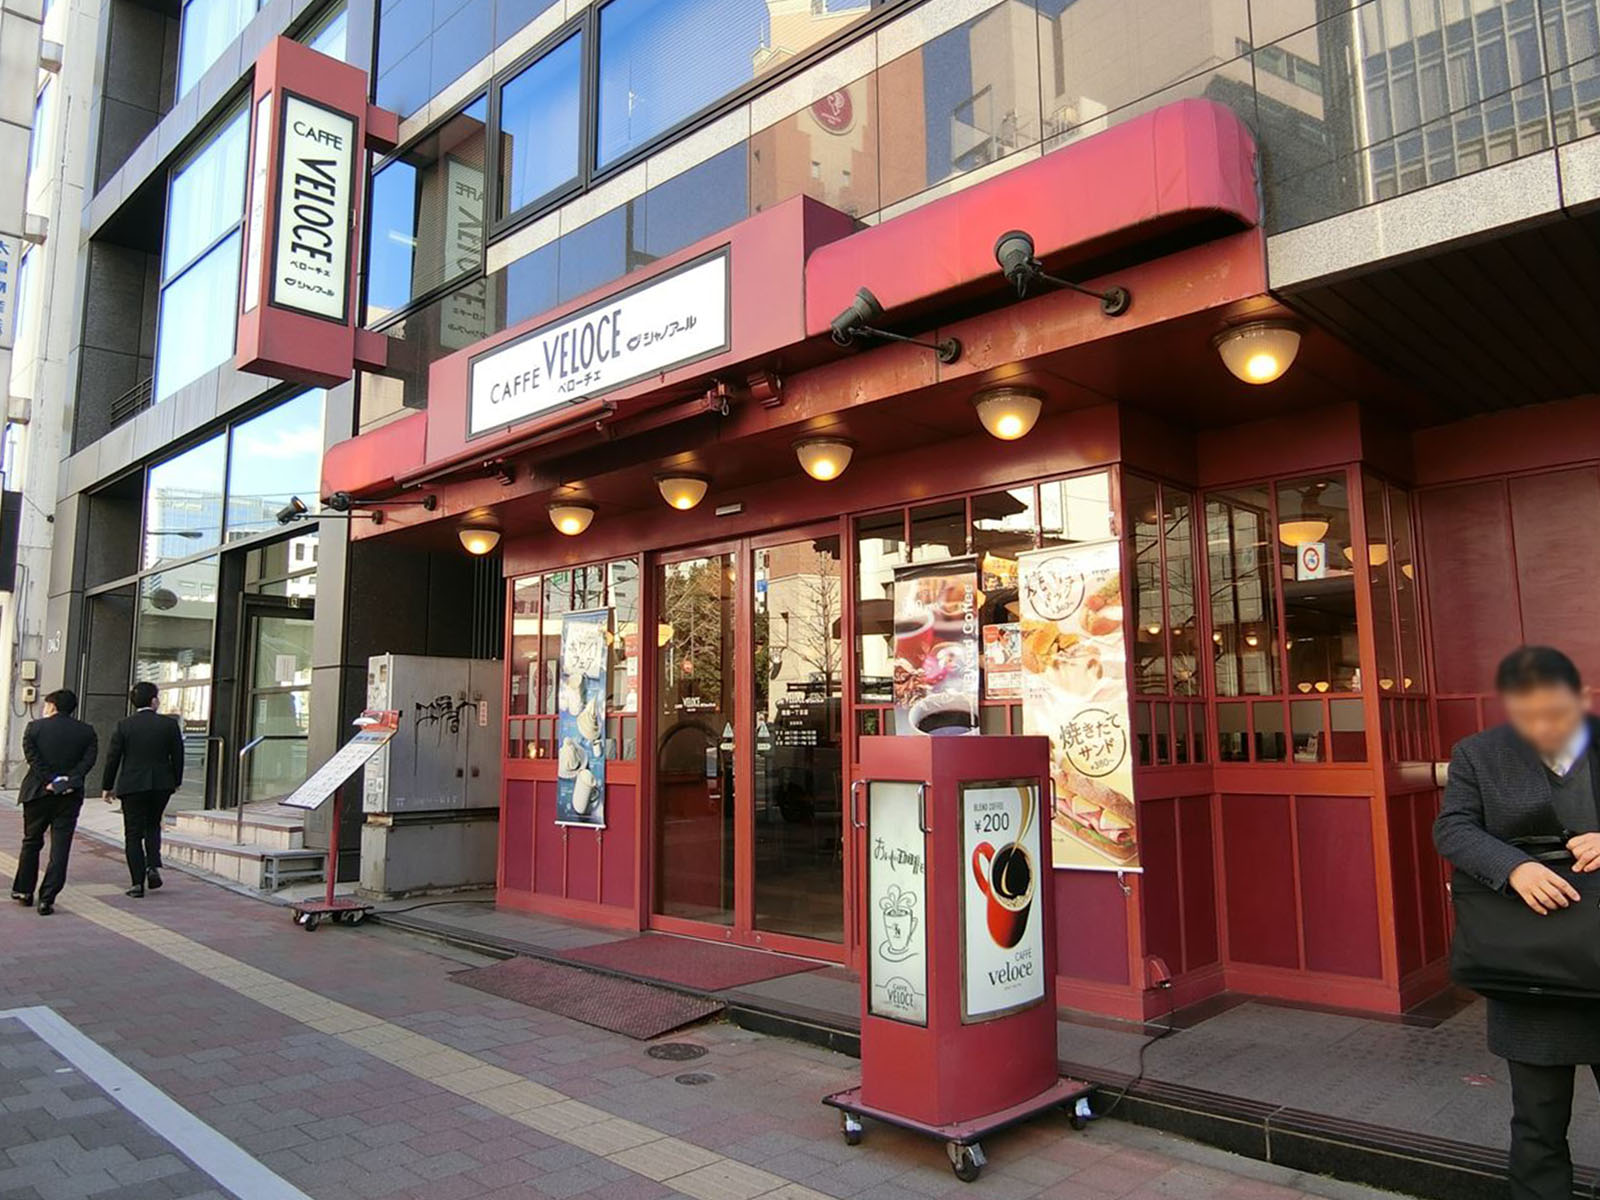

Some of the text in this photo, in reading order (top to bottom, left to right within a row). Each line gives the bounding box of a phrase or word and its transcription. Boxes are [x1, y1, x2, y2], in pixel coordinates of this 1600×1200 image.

[294, 121, 343, 151] CAFFE
[290, 158, 337, 264] VELOCE
[643, 314, 698, 347] シャノアール
[490, 308, 622, 405] CAFFE VELOCE
[963, 584, 975, 634] Coffee
[1060, 713, 1121, 750] 焼きたて
[1079, 738, 1114, 761] サンド
[987, 962, 1033, 986] veloce
[887, 988, 914, 1008] VELOCE
